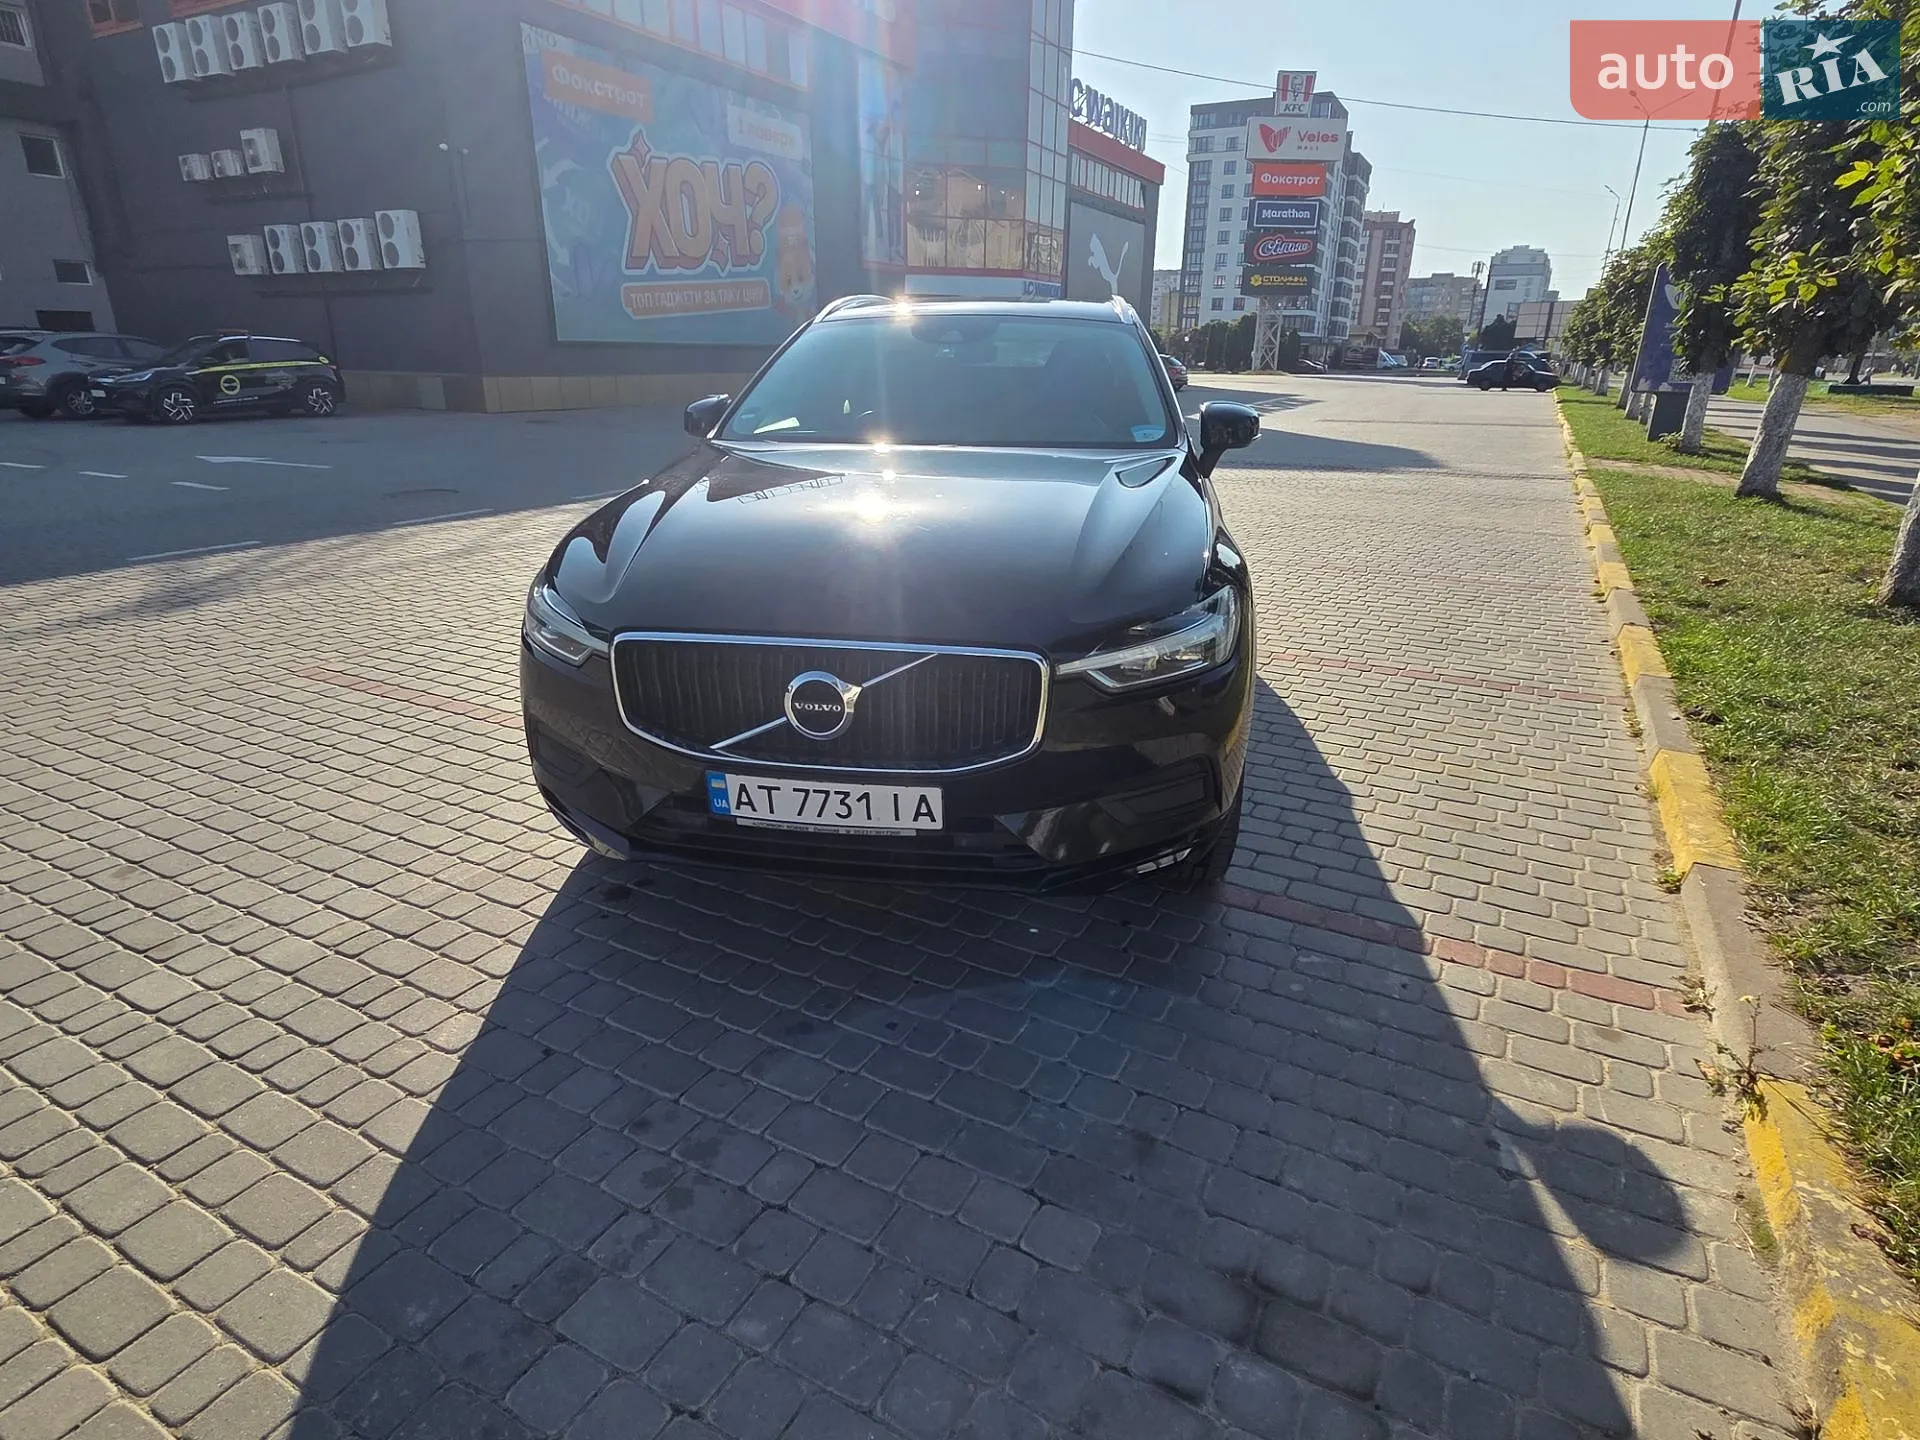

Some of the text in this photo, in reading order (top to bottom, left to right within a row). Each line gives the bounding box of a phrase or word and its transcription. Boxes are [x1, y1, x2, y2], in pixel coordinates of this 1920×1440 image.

[552, 63, 647, 108] Фокстрот
[1283, 103, 1306, 113] KFC
[1297, 130, 1339, 143] Veles
[1260, 172, 1321, 187] Фокстрот
[1261, 207, 1311, 219] Marathon
[630, 292, 653, 308] ТОП
[703, 288, 717, 304] ЗА
[793, 702, 842, 712] VOLVO
[714, 798, 729, 808] UA
[735, 783, 781, 815] AT
[792, 787, 872, 821] 7731
